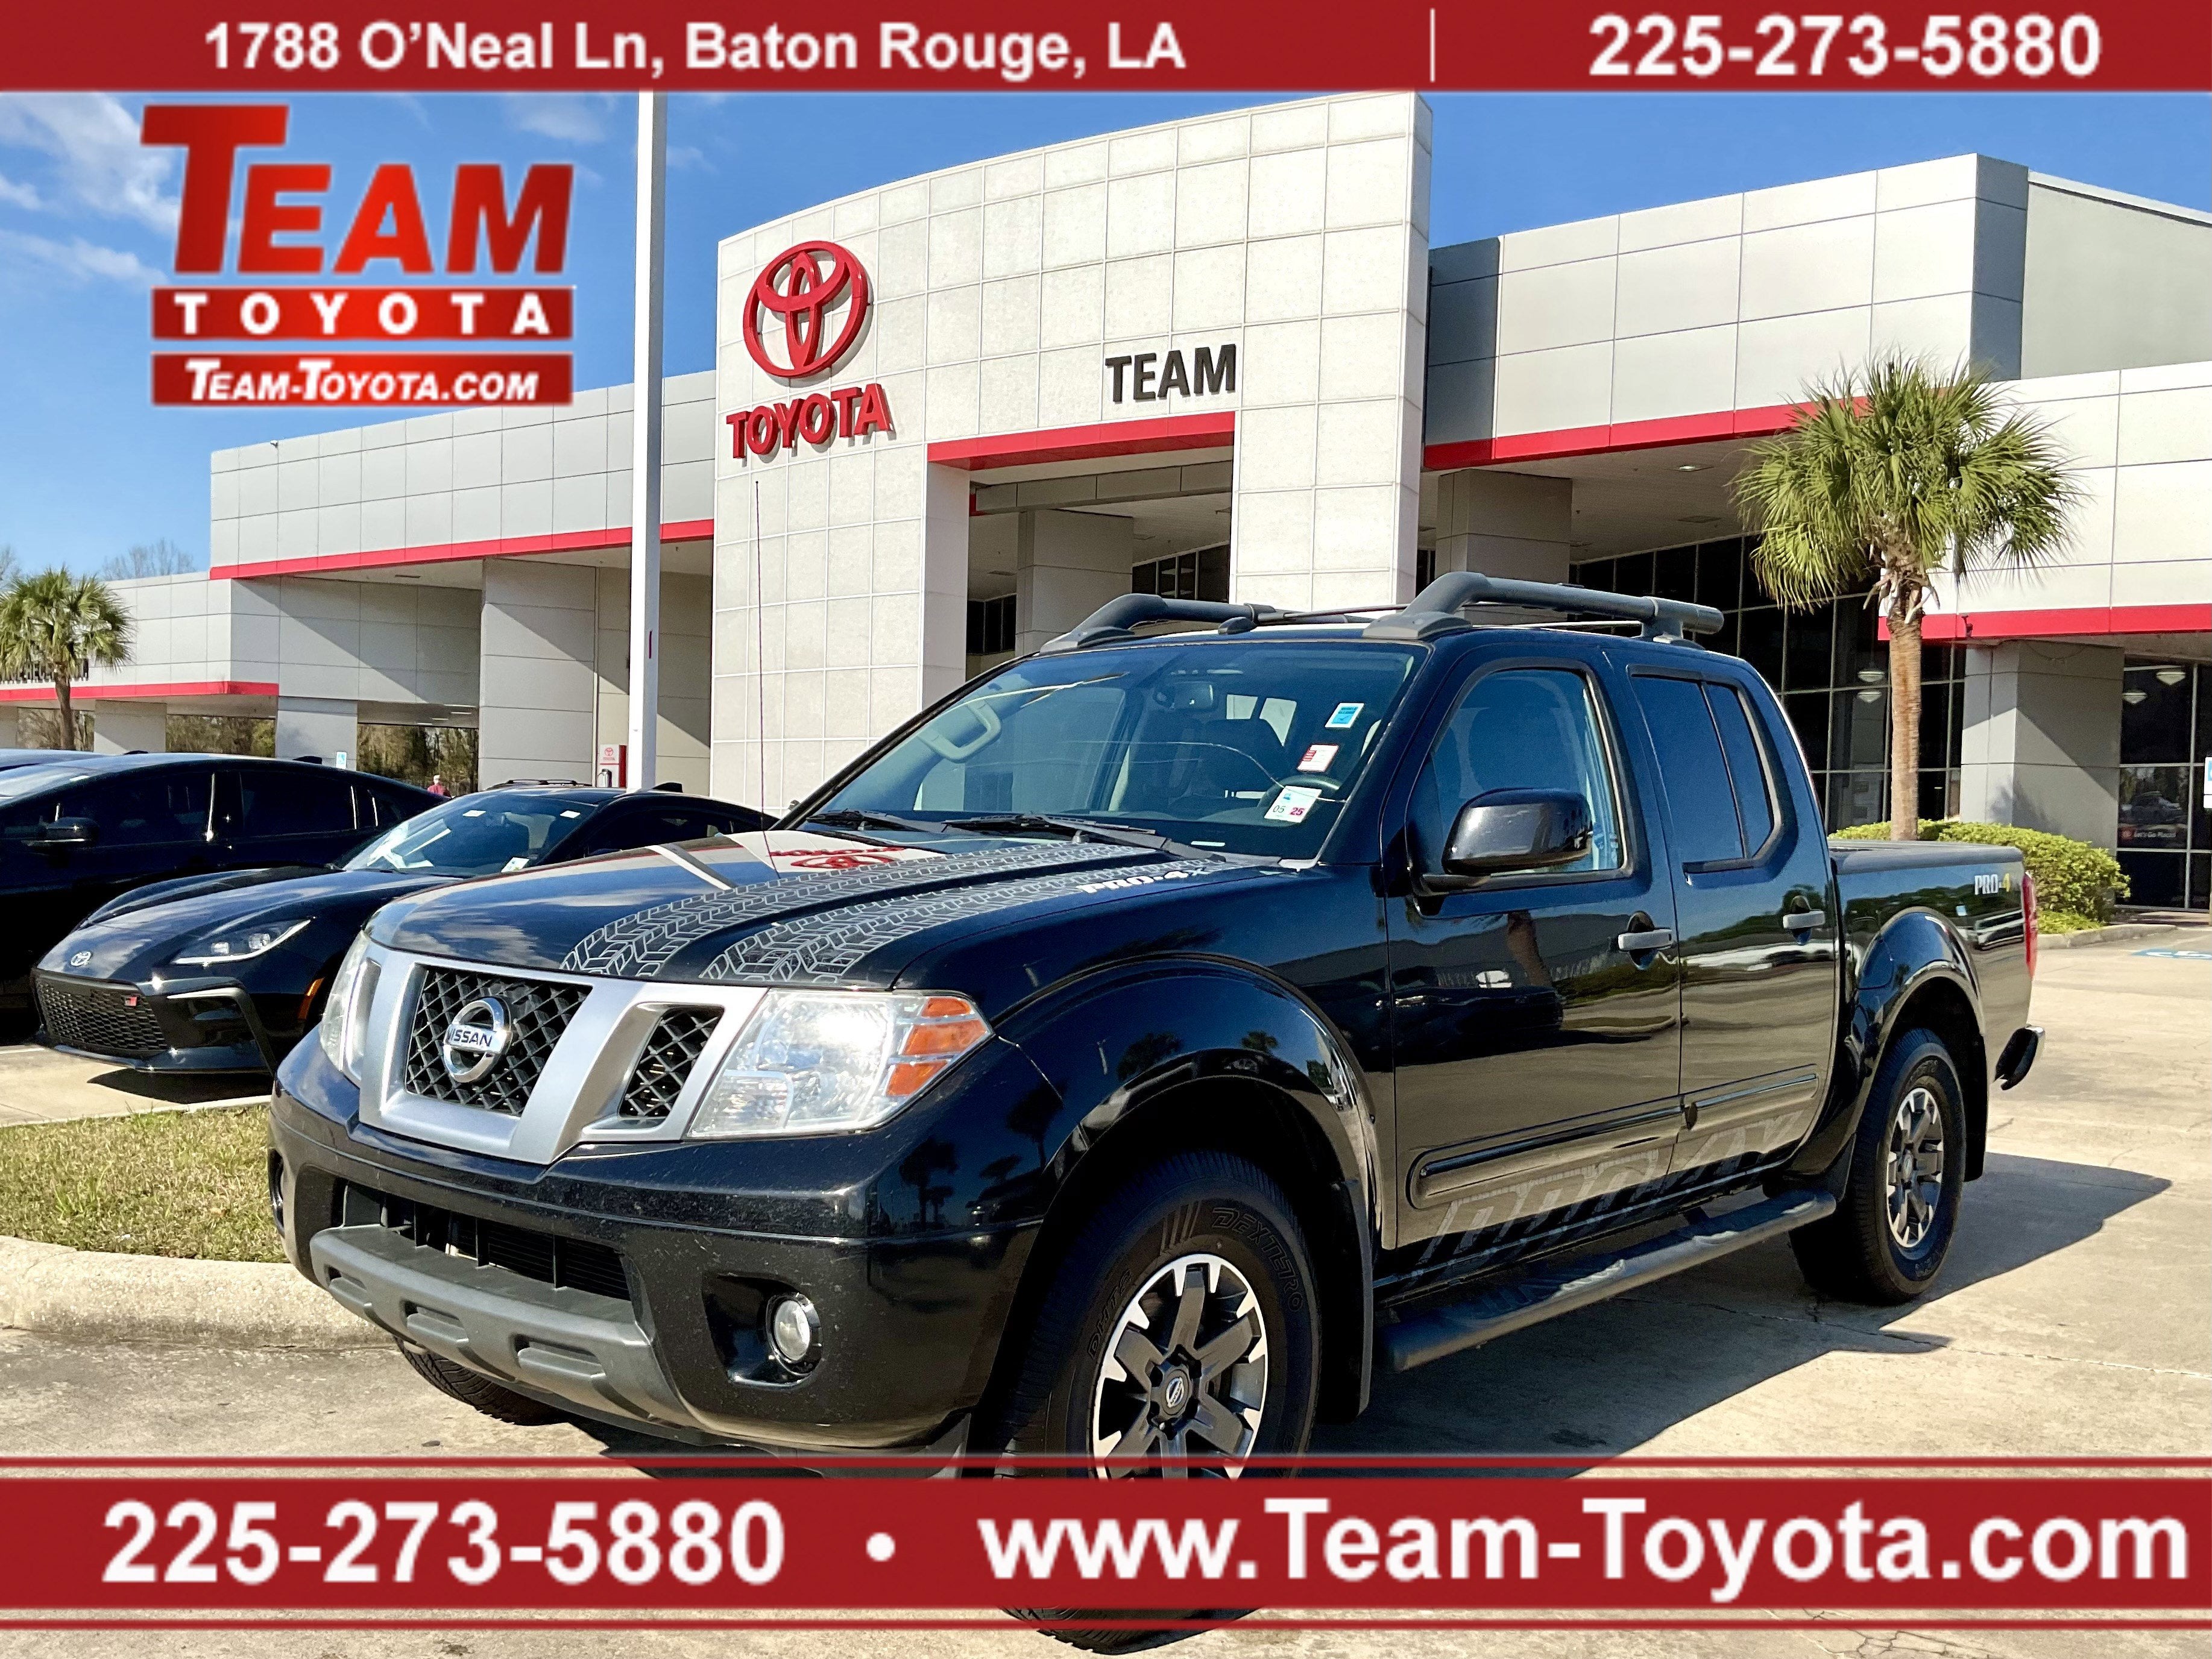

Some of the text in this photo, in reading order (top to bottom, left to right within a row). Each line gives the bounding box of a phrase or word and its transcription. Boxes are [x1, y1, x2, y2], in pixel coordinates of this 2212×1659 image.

[1105, 344, 1236, 402] TEAM
[726, 383, 894, 459] TOYOTA
[1272, 805, 1305, 816] 05 25
[446, 1027, 493, 1047] NISSAN
[1211, 1206, 1303, 1314] DEXTERO
